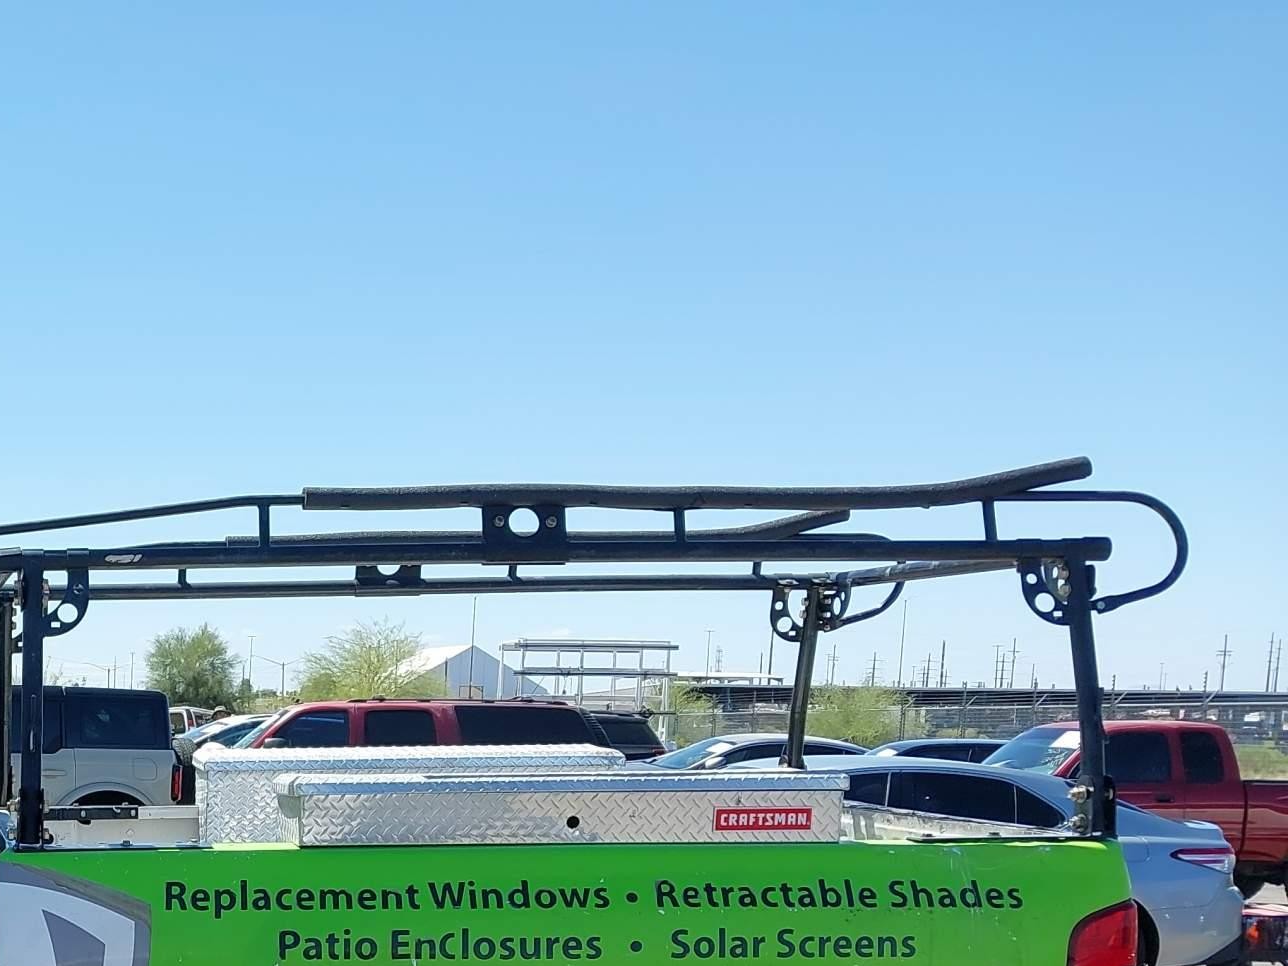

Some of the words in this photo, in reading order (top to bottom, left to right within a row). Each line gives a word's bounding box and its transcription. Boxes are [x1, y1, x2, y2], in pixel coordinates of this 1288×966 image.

[164, 879, 420, 919] Replacement
[428, 880, 610, 910] Windows
[656, 878, 877, 909] Retractable
[889, 880, 1023, 909] Shades
[279, 929, 378, 960] Patio
[671, 928, 765, 959] Solar
[776, 928, 916, 959] Screens
